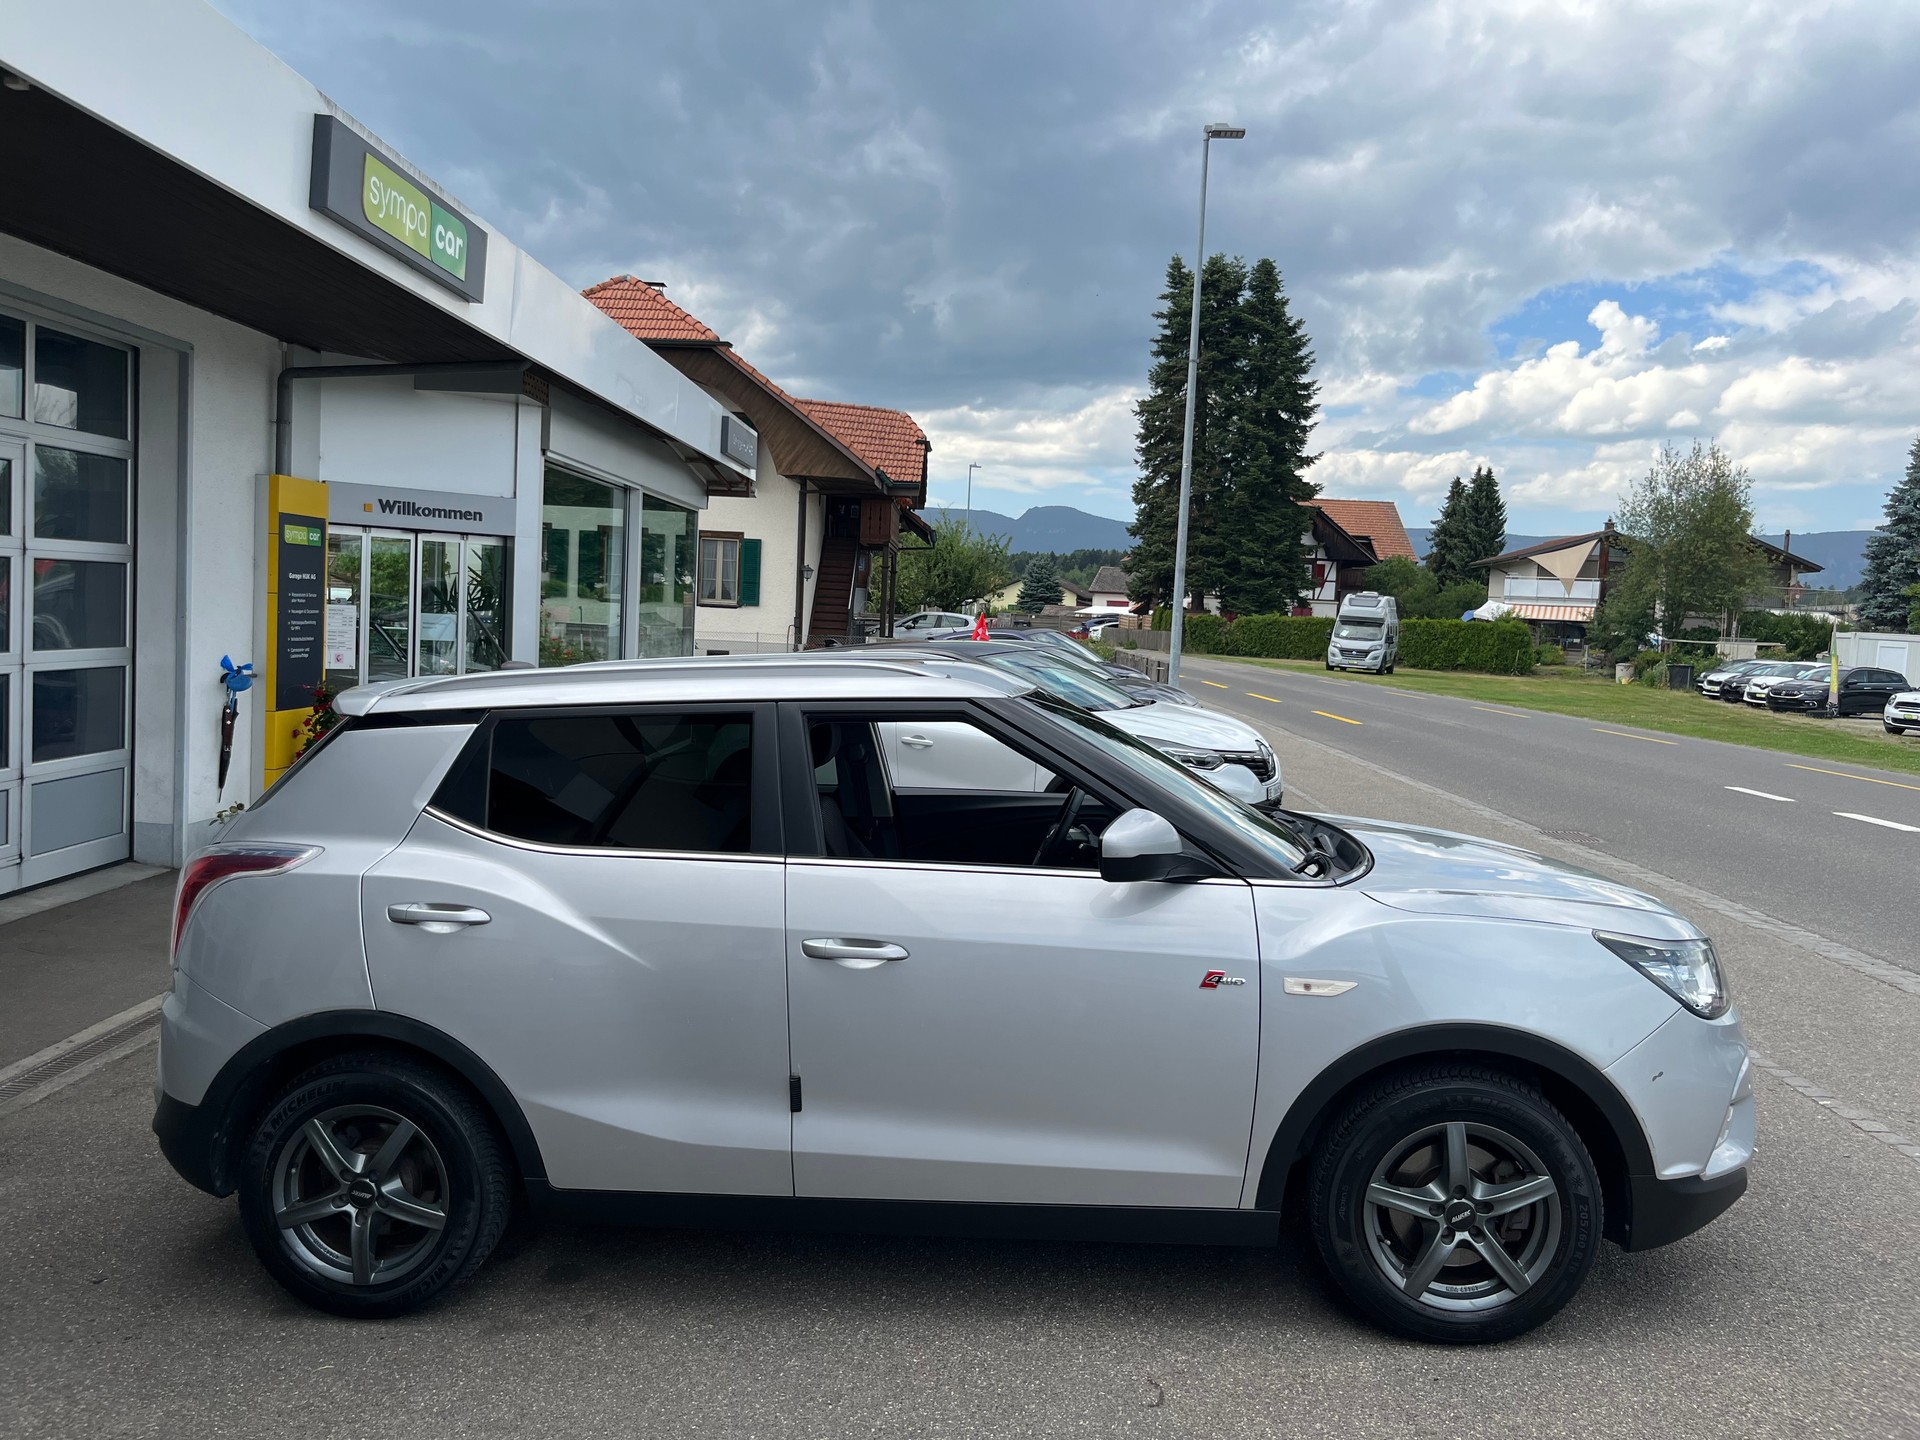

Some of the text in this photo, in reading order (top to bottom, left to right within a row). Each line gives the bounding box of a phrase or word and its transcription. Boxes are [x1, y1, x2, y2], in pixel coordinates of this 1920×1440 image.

[369, 176, 464, 259] sympa car
[378, 498, 483, 521] Willkommen
[286, 530, 321, 542] sympa car
[288, 572, 302, 580] Garage
[270, 1081, 346, 1132] MICHELIN
[1578, 1204, 1589, 1249] 205/60
